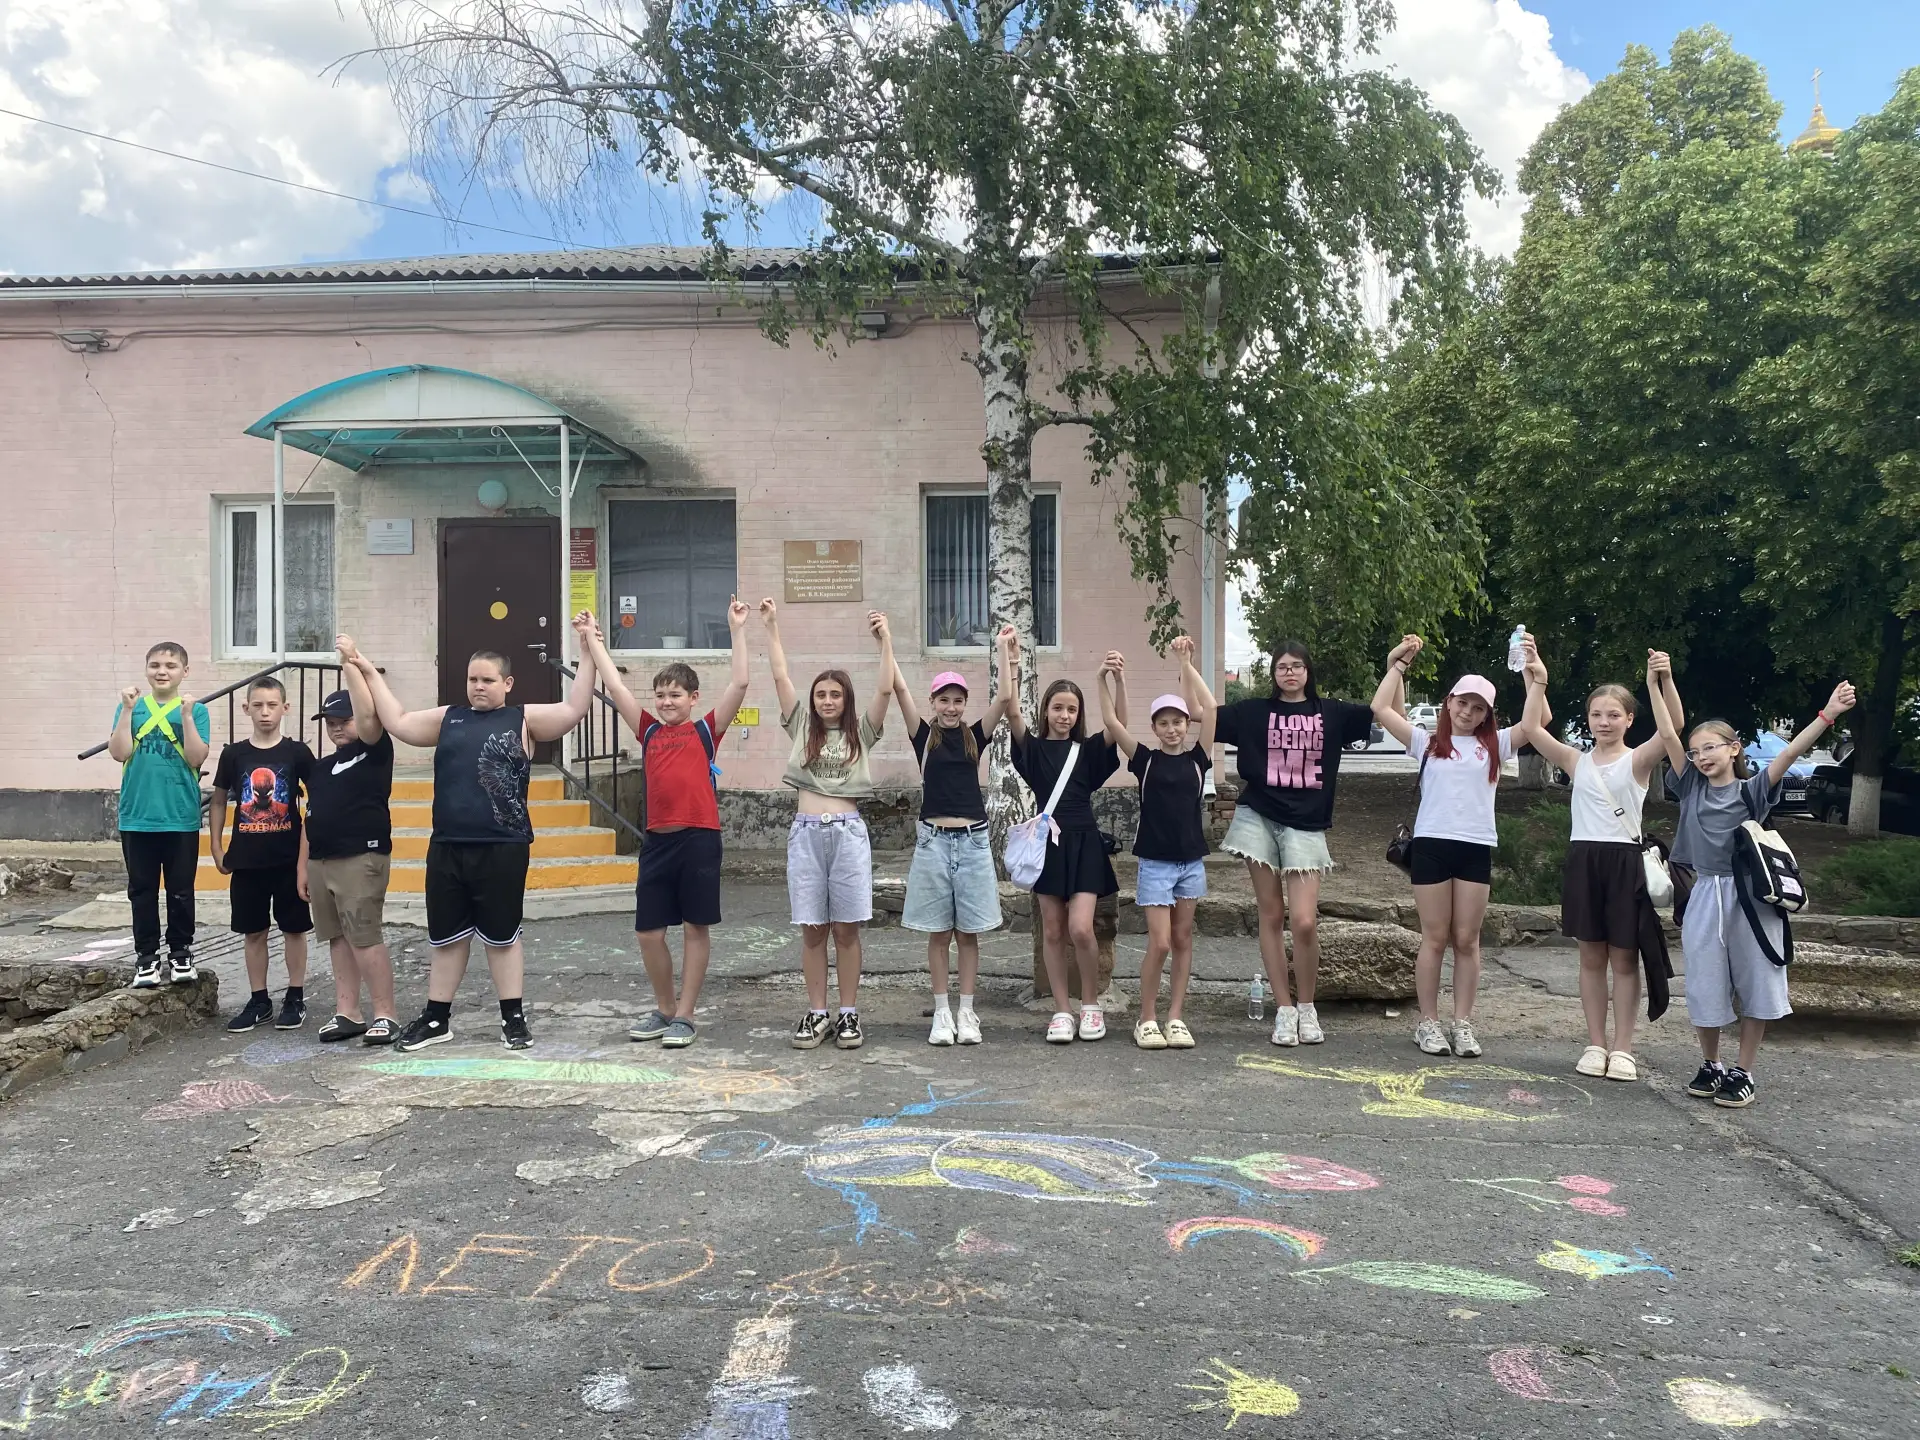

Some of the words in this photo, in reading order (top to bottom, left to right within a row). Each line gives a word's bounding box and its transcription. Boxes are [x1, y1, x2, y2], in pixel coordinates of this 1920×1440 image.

[1268, 712, 1277, 730] I
[1279, 713, 1324, 732] LOVE
[1267, 729, 1324, 751] BEING
[1266, 749, 1323, 790] ME
[340, 1232, 715, 1301] ЛЕТО
